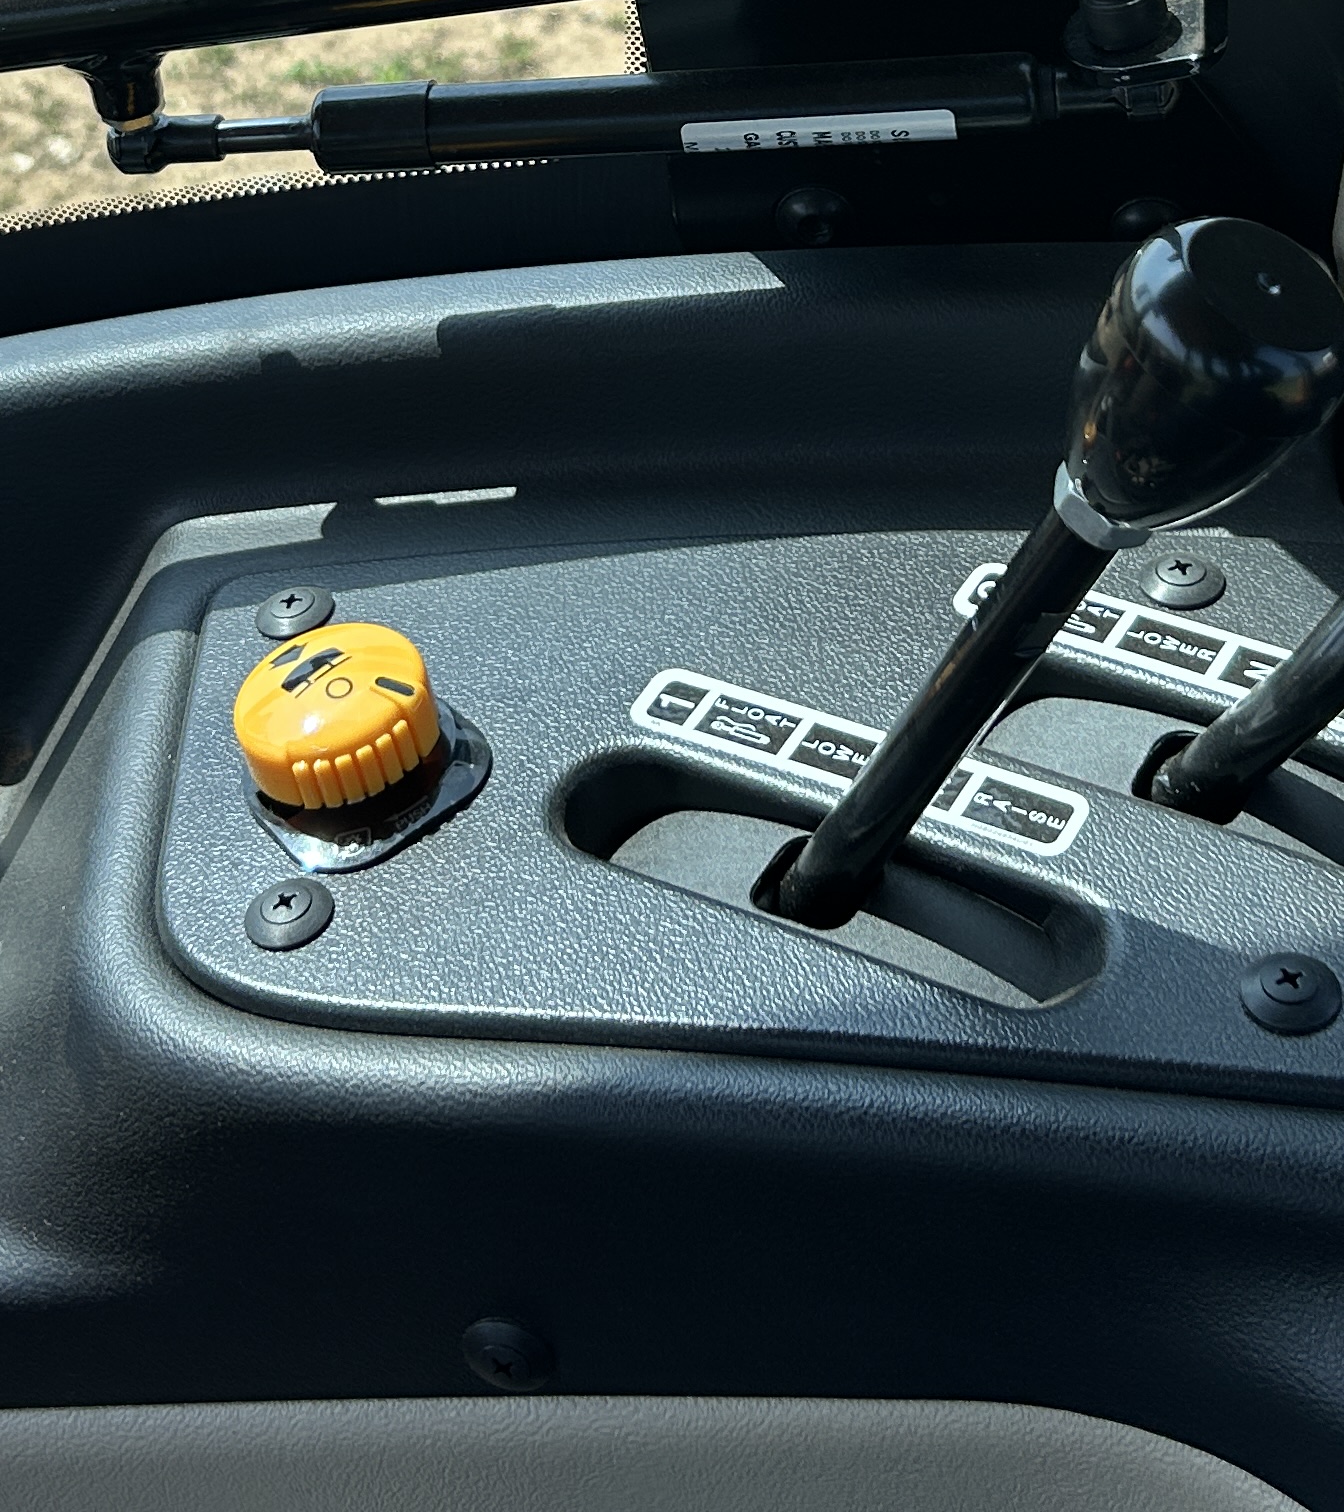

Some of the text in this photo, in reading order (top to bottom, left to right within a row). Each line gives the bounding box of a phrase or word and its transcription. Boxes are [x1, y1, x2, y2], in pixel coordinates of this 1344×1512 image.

[1126, 628, 1218, 663] LOWER
[659, 692, 696, 710] 1
[714, 696, 797, 730] FLOAT
[801, 738, 871, 766] LOWE
[973, 791, 1067, 831] RAISE
